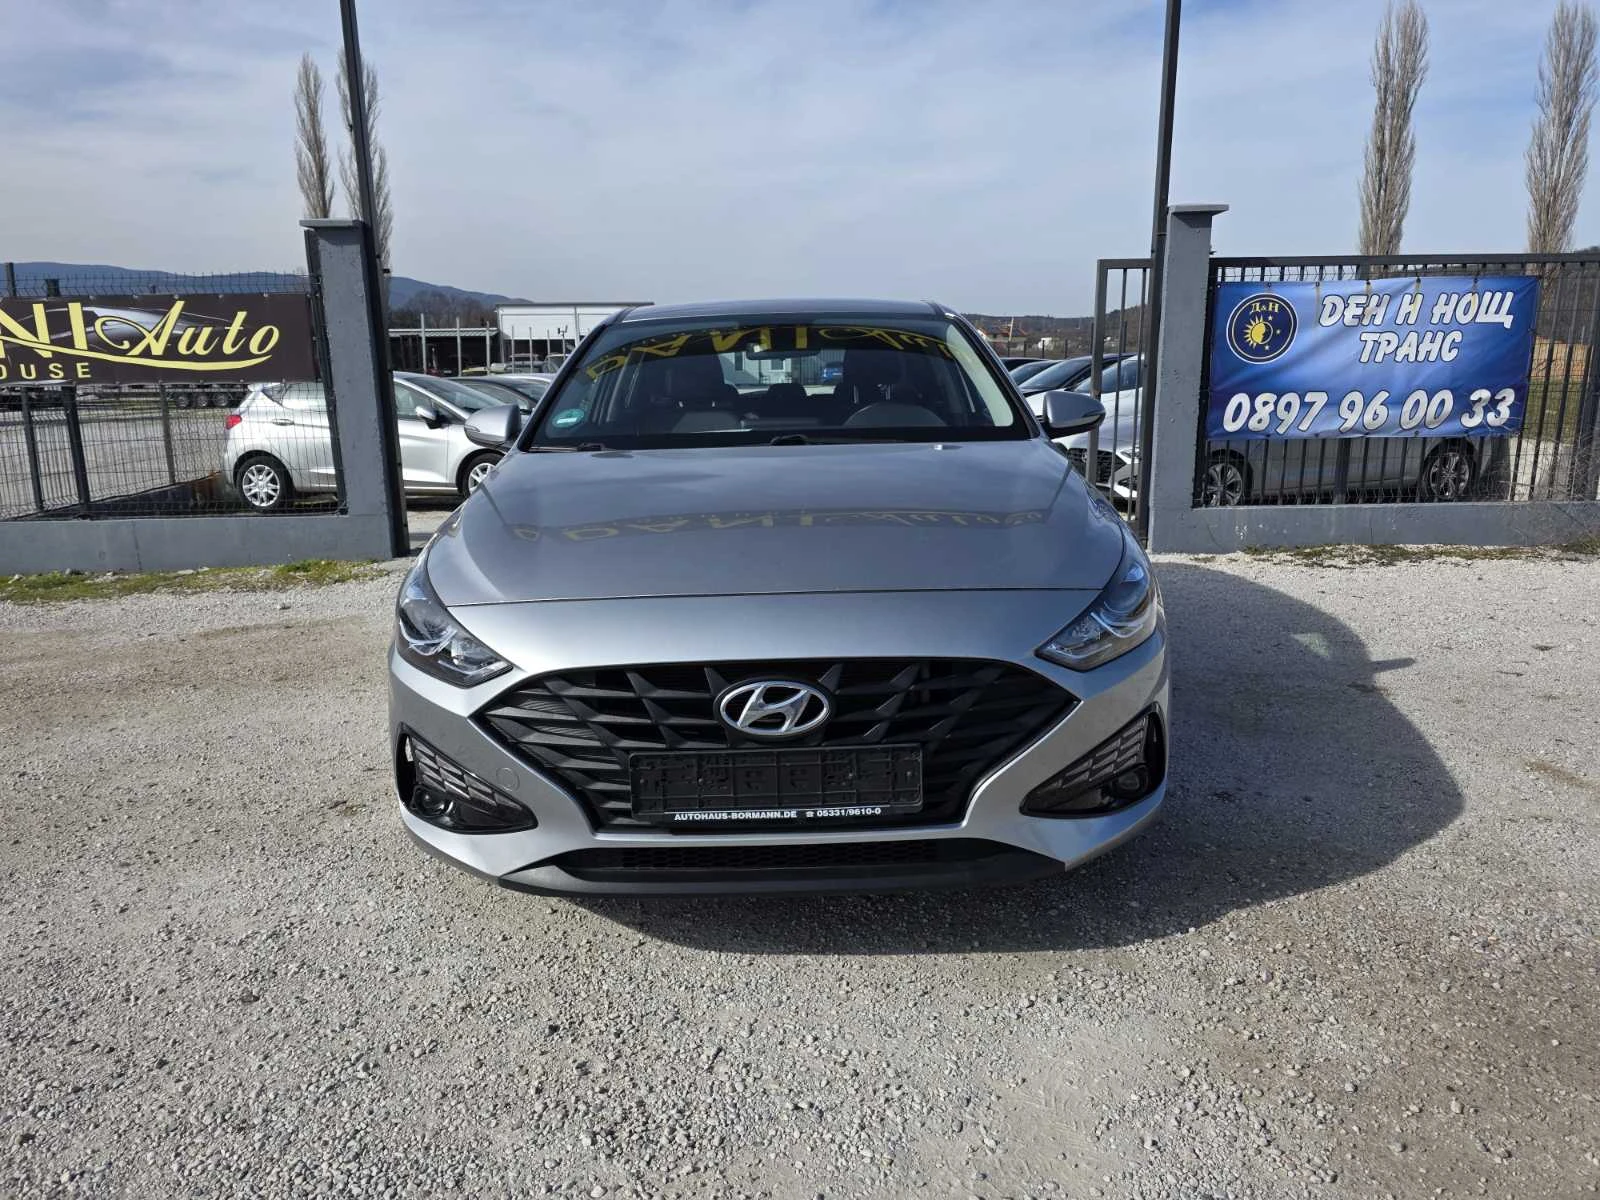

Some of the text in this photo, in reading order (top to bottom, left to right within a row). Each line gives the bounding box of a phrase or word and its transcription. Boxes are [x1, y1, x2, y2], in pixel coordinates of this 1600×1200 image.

[94, 300, 280, 356] Auto
[1431, 291, 1514, 329] НОЩ
[1360, 331, 1462, 363] ТРАНС
[1223, 388, 1516, 434] 0897 96 00 33
[674, 807, 882, 821] AUTOHAUS-BORMANN.DE 05331/9610-0
